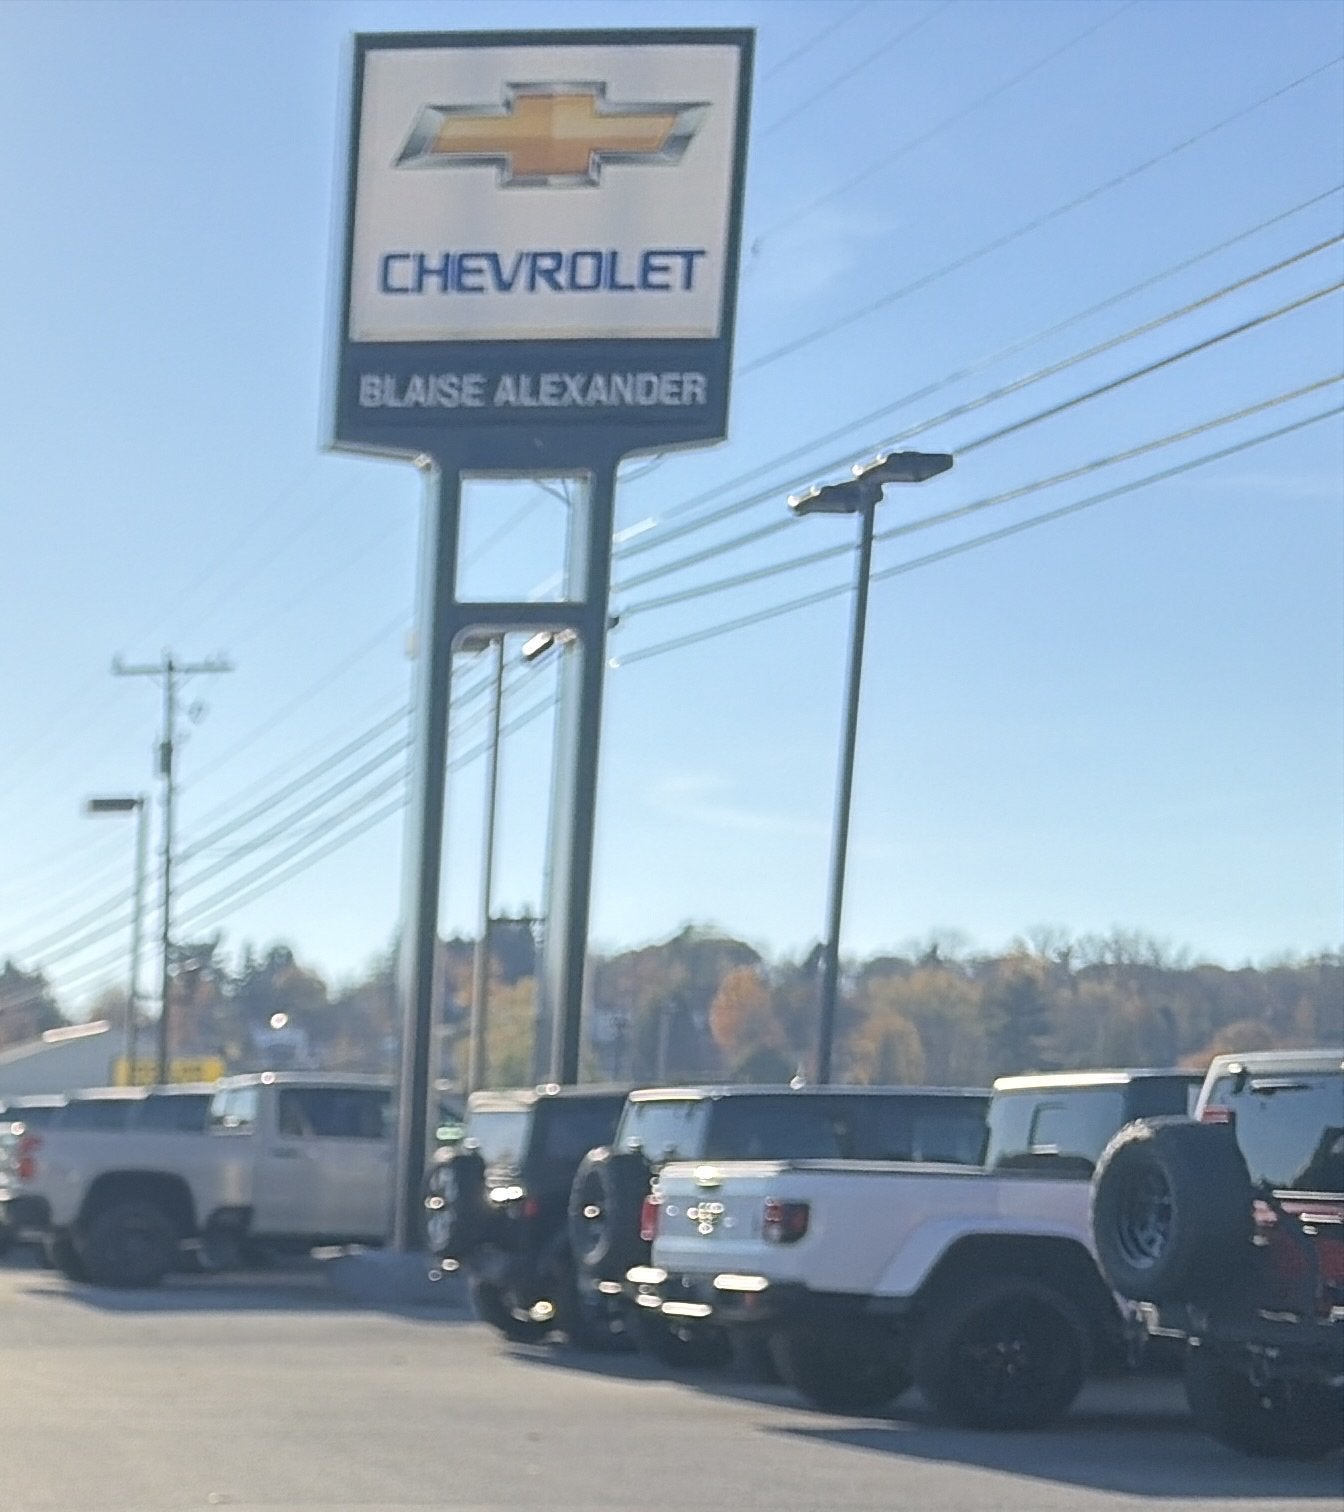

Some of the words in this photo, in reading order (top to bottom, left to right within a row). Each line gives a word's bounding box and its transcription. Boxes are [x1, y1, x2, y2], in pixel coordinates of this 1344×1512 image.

[382, 249, 706, 293] CHEVROLET
[358, 373, 486, 408] BLAISE
[494, 372, 707, 406] ALEXANDER
